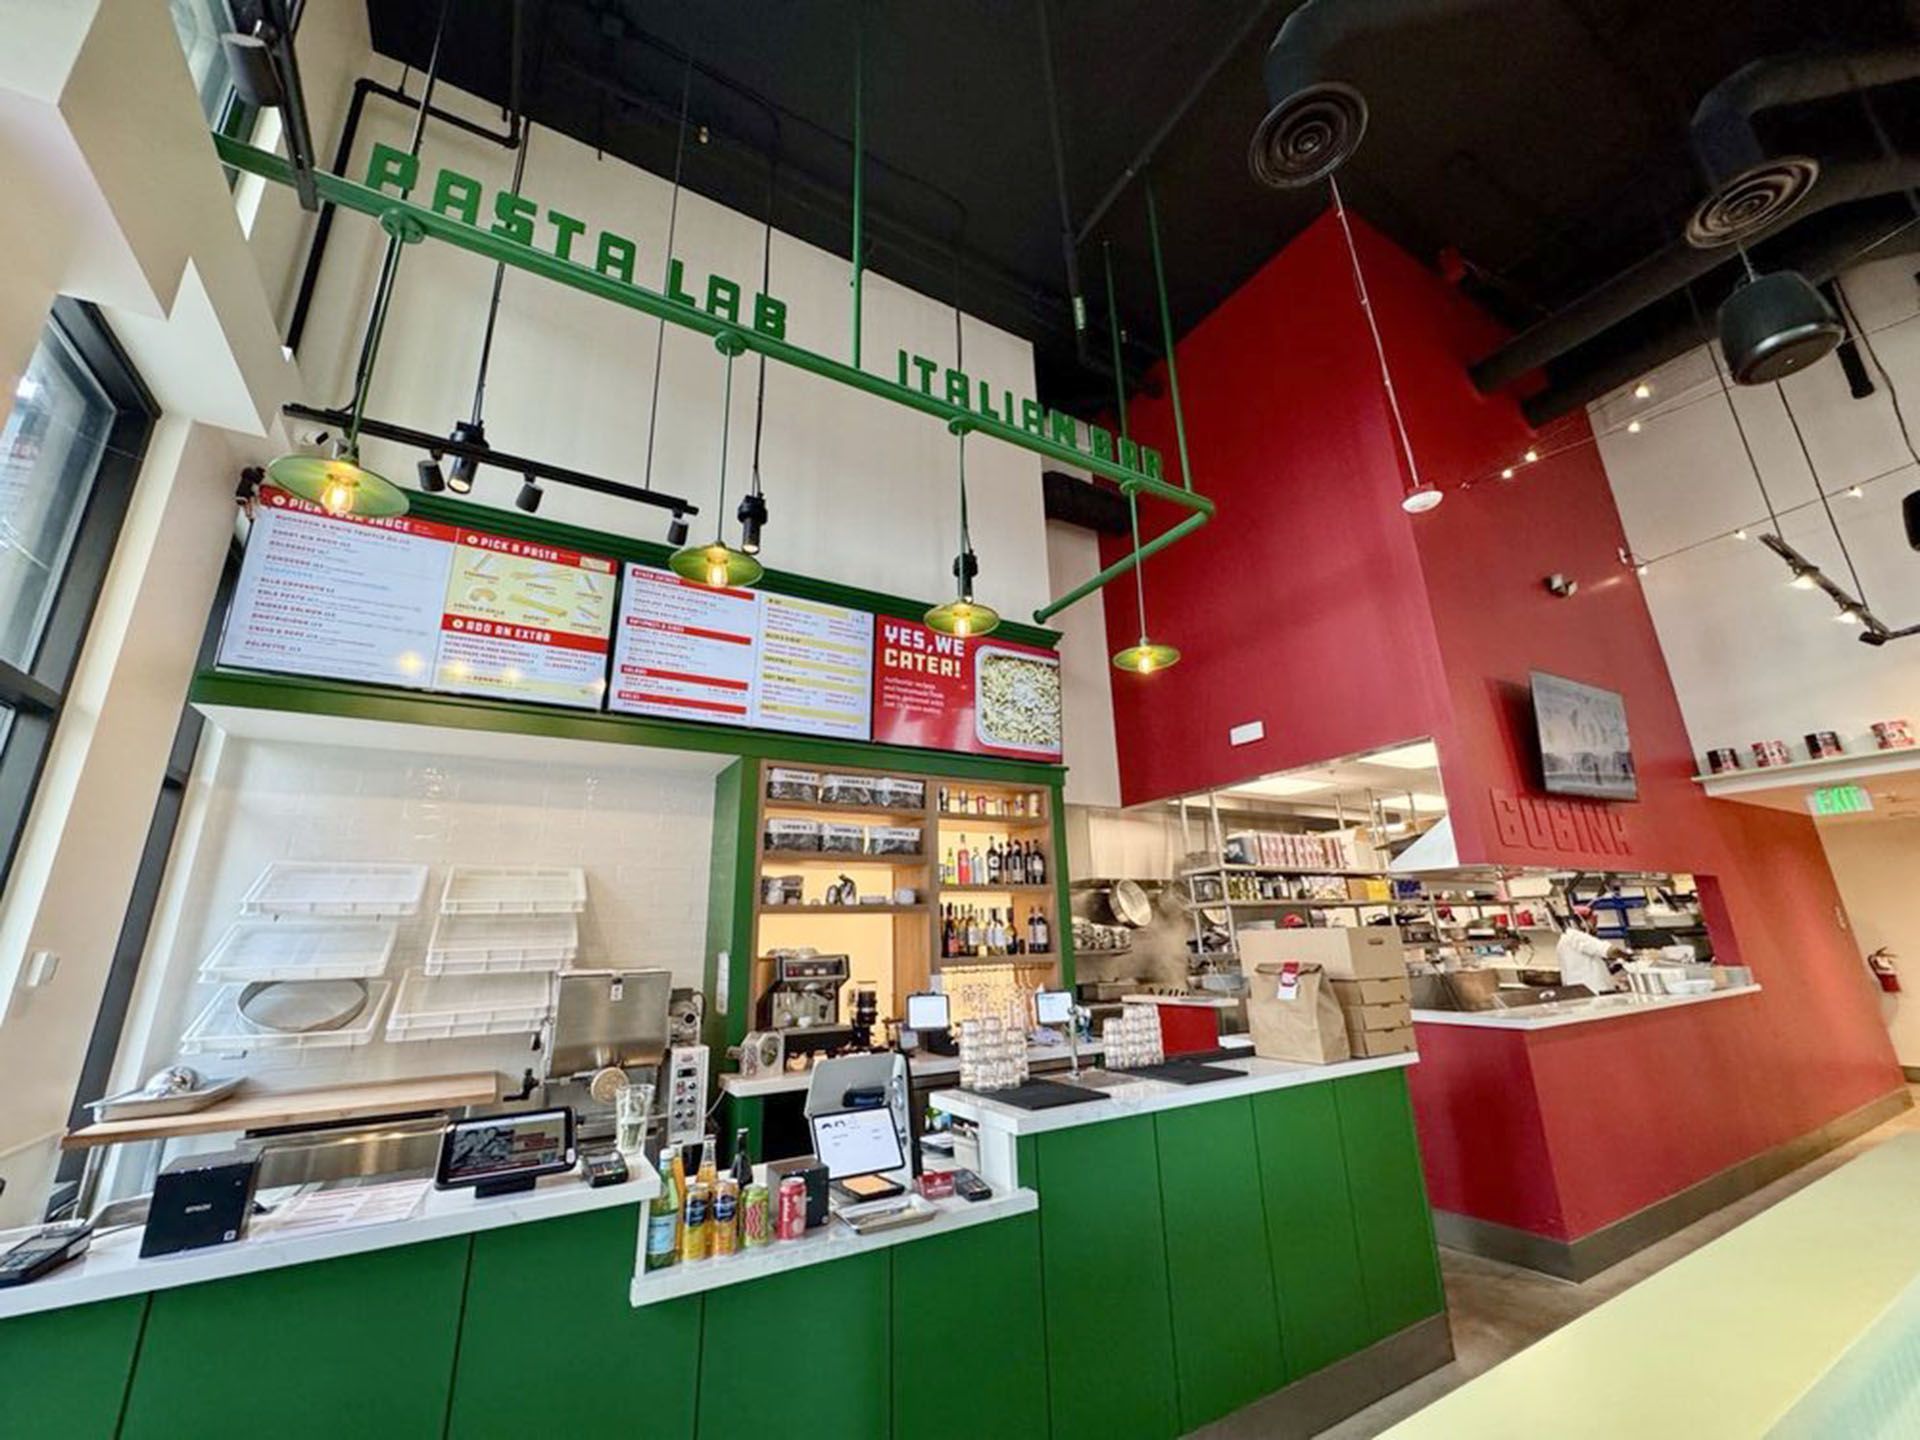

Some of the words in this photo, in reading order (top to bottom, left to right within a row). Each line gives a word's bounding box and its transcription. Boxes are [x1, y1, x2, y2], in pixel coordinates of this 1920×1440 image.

[365, 142, 637, 285] PASTA
[666, 258, 788, 341] LAB
[898, 349, 1079, 451] ITALIAN
[1090, 424, 1164, 481] BAR
[481, 536, 509, 551] PICK
[523, 544, 558, 561] PASTA
[466, 619, 492, 635] ADD
[515, 627, 553, 643] EXTRA
[884, 624, 934, 653] YES,
[935, 635, 965, 657] WE
[884, 648, 961, 678] CATER!
[1815, 785, 1864, 815] EXIT
